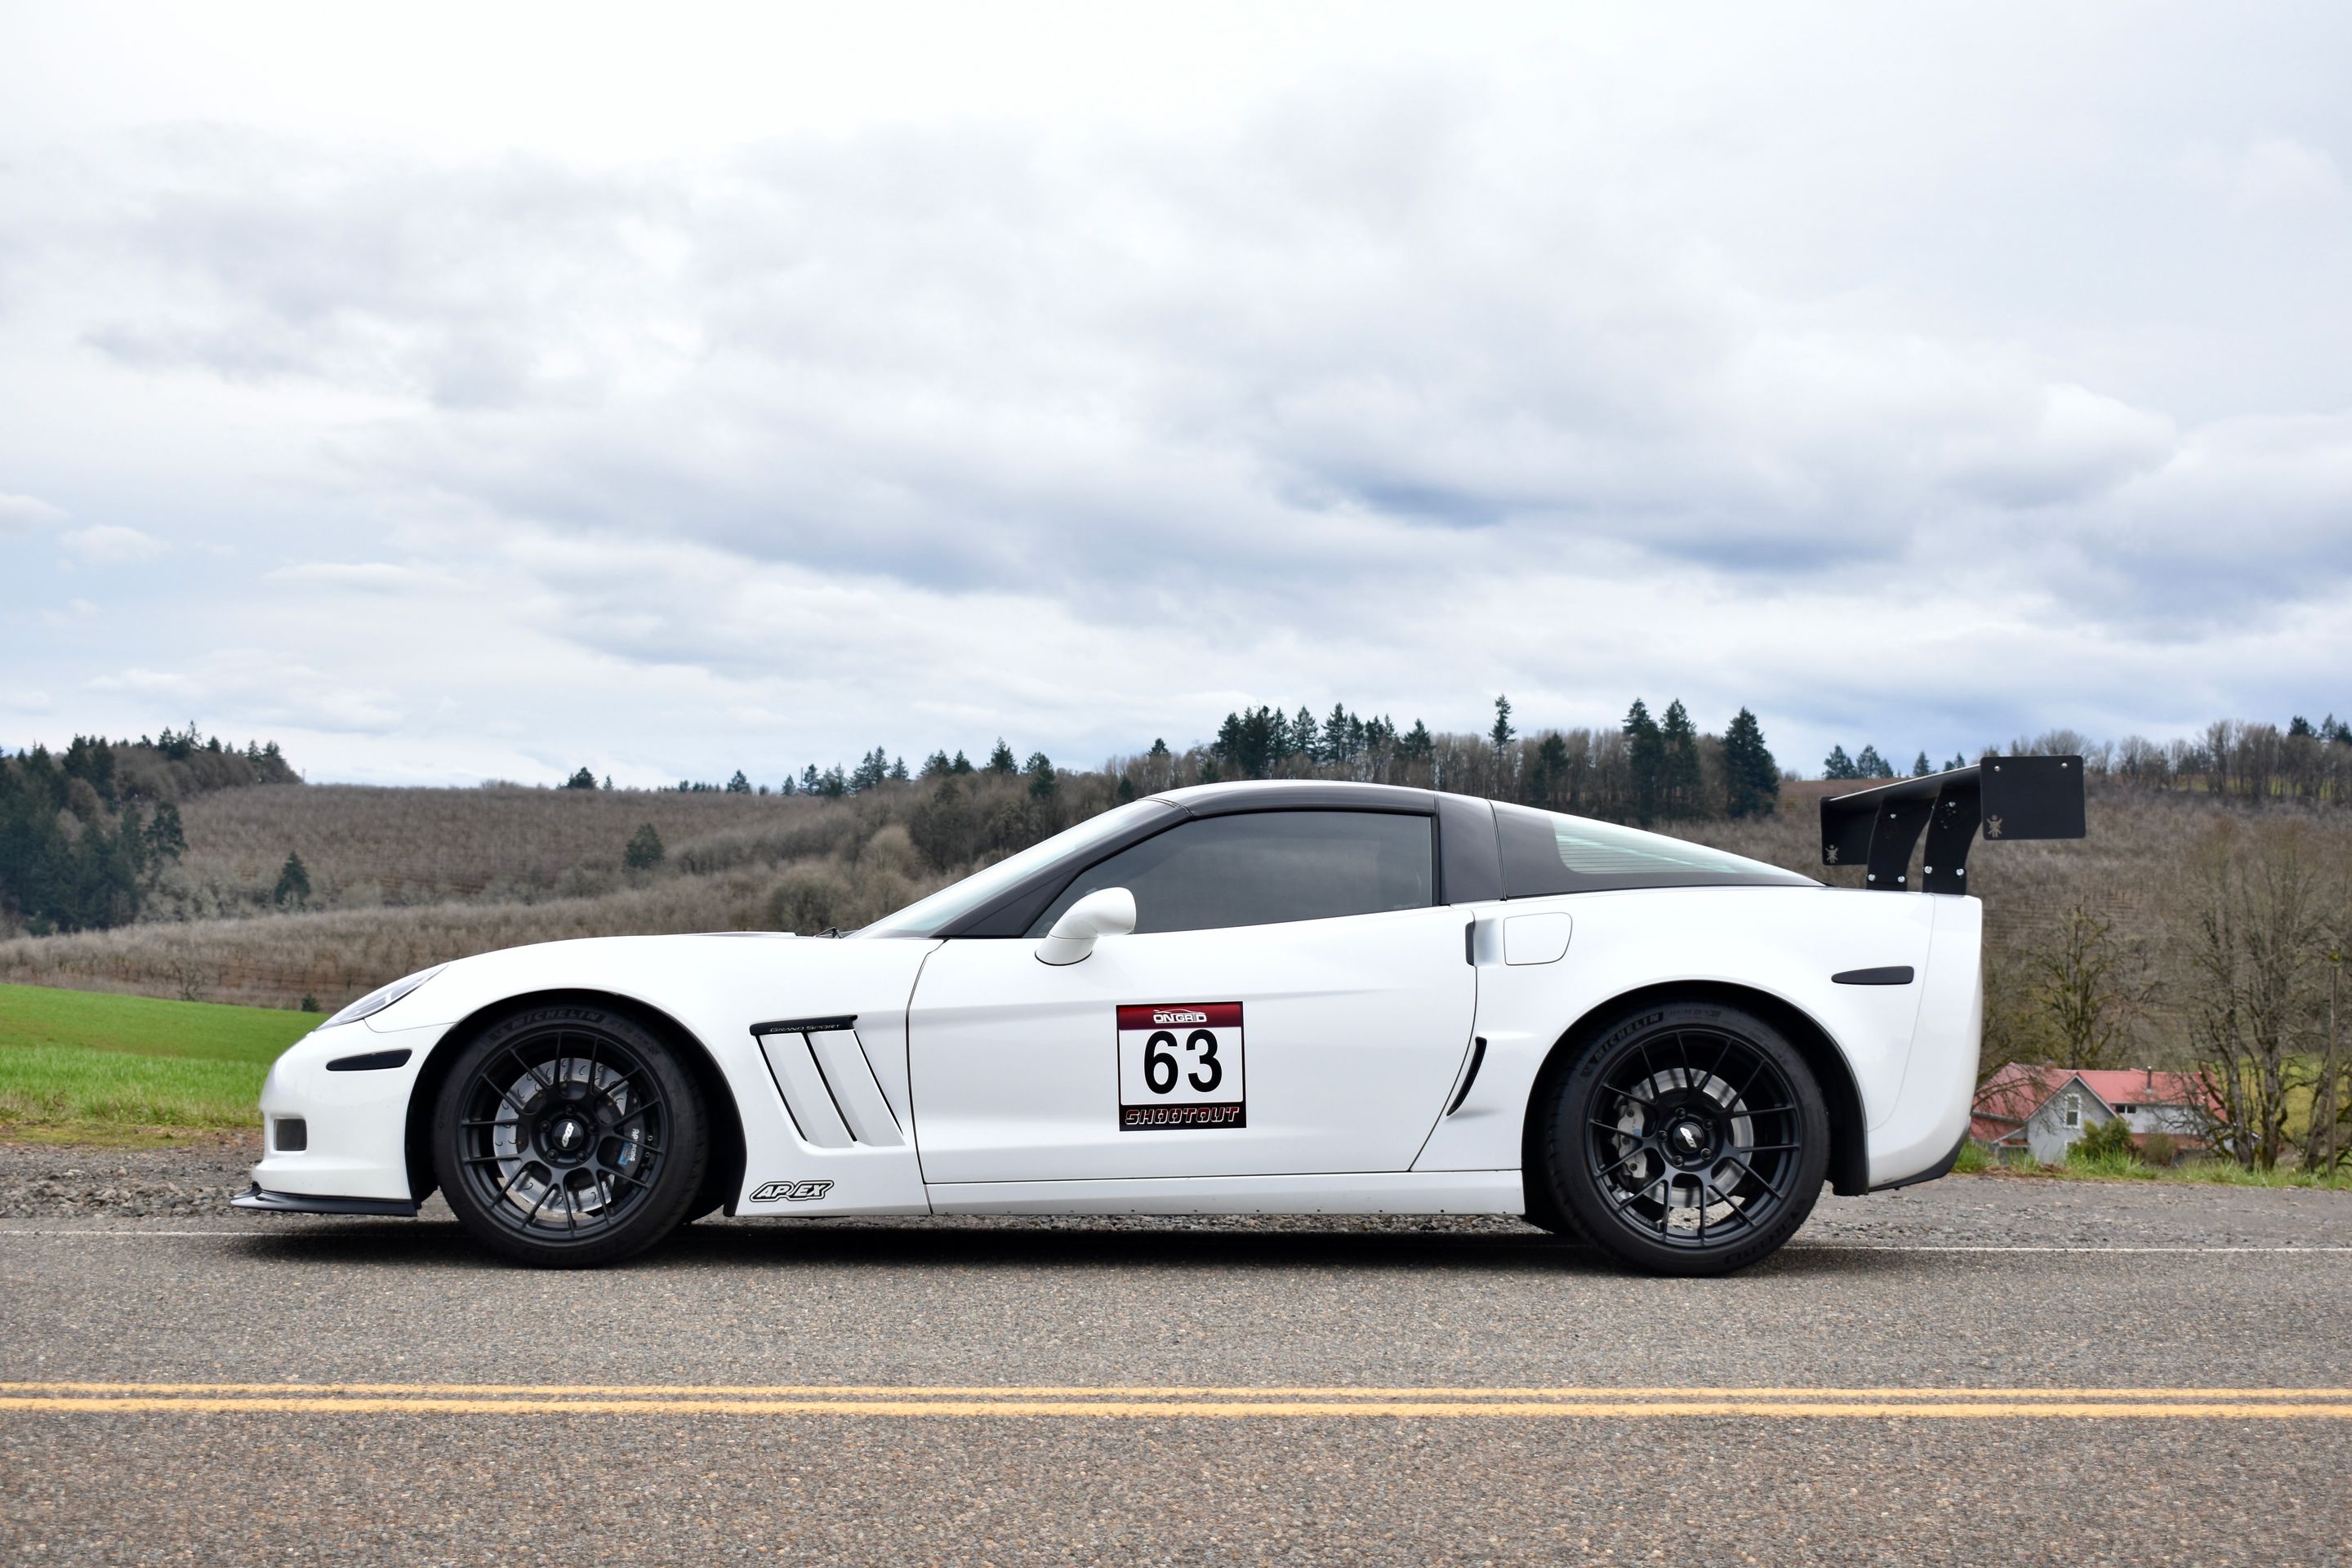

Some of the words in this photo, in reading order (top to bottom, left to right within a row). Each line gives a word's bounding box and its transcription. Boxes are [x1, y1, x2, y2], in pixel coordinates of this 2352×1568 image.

[511, 1009, 601, 1029] MICHELIN
[1593, 1012, 1661, 1060] MICHELIN
[1144, 1029, 1222, 1094] 63
[1125, 1107, 1240, 1125] SHOOTOUT
[752, 1183, 831, 1200] APEX
